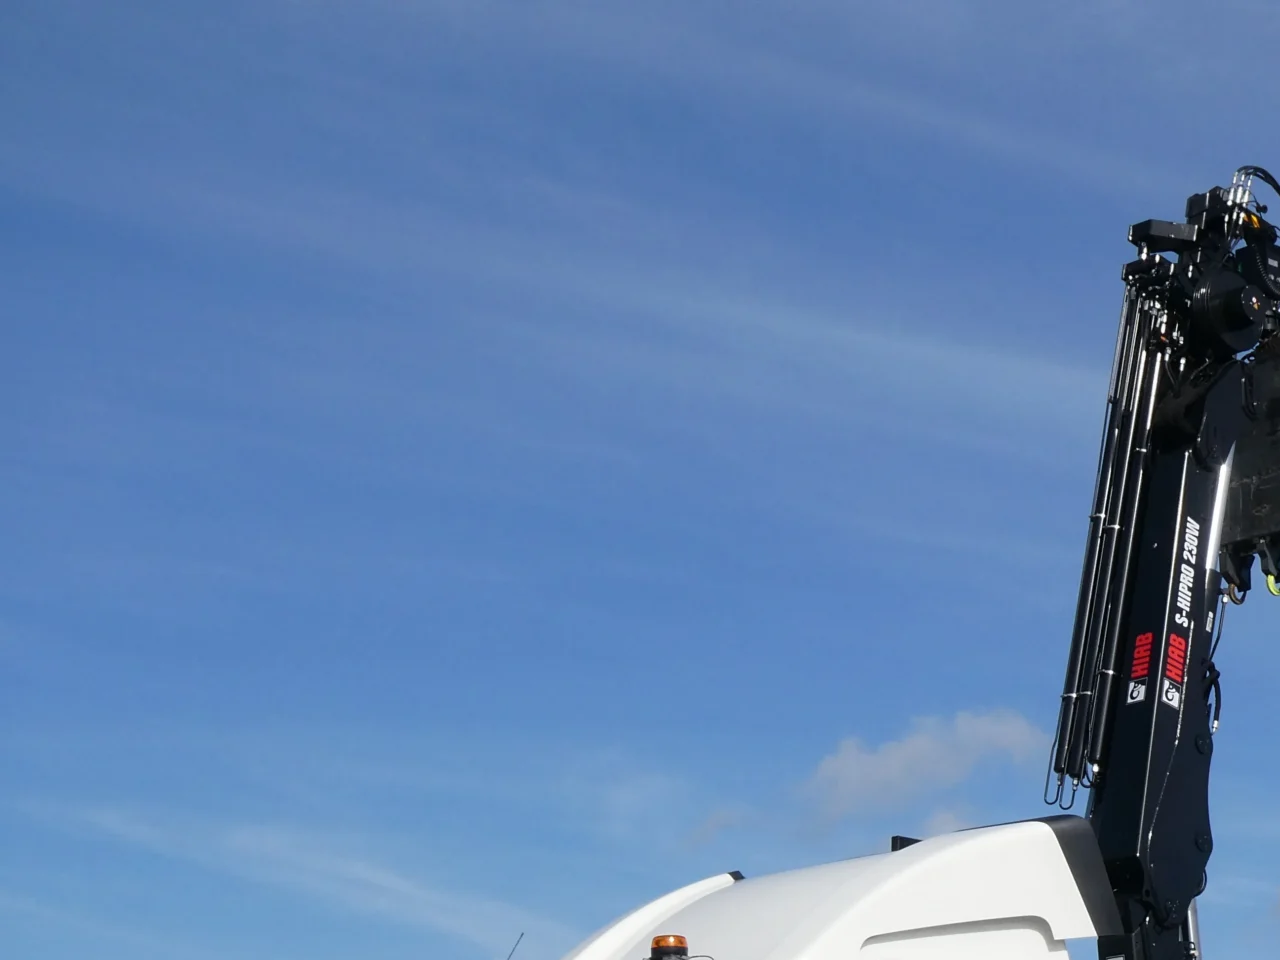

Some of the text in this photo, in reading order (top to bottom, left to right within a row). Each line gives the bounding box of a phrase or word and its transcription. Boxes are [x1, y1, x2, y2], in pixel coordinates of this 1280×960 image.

[1166, 516, 1200, 683] HIAB S-HIPRO 230W
[1131, 632, 1153, 678] HIAB
